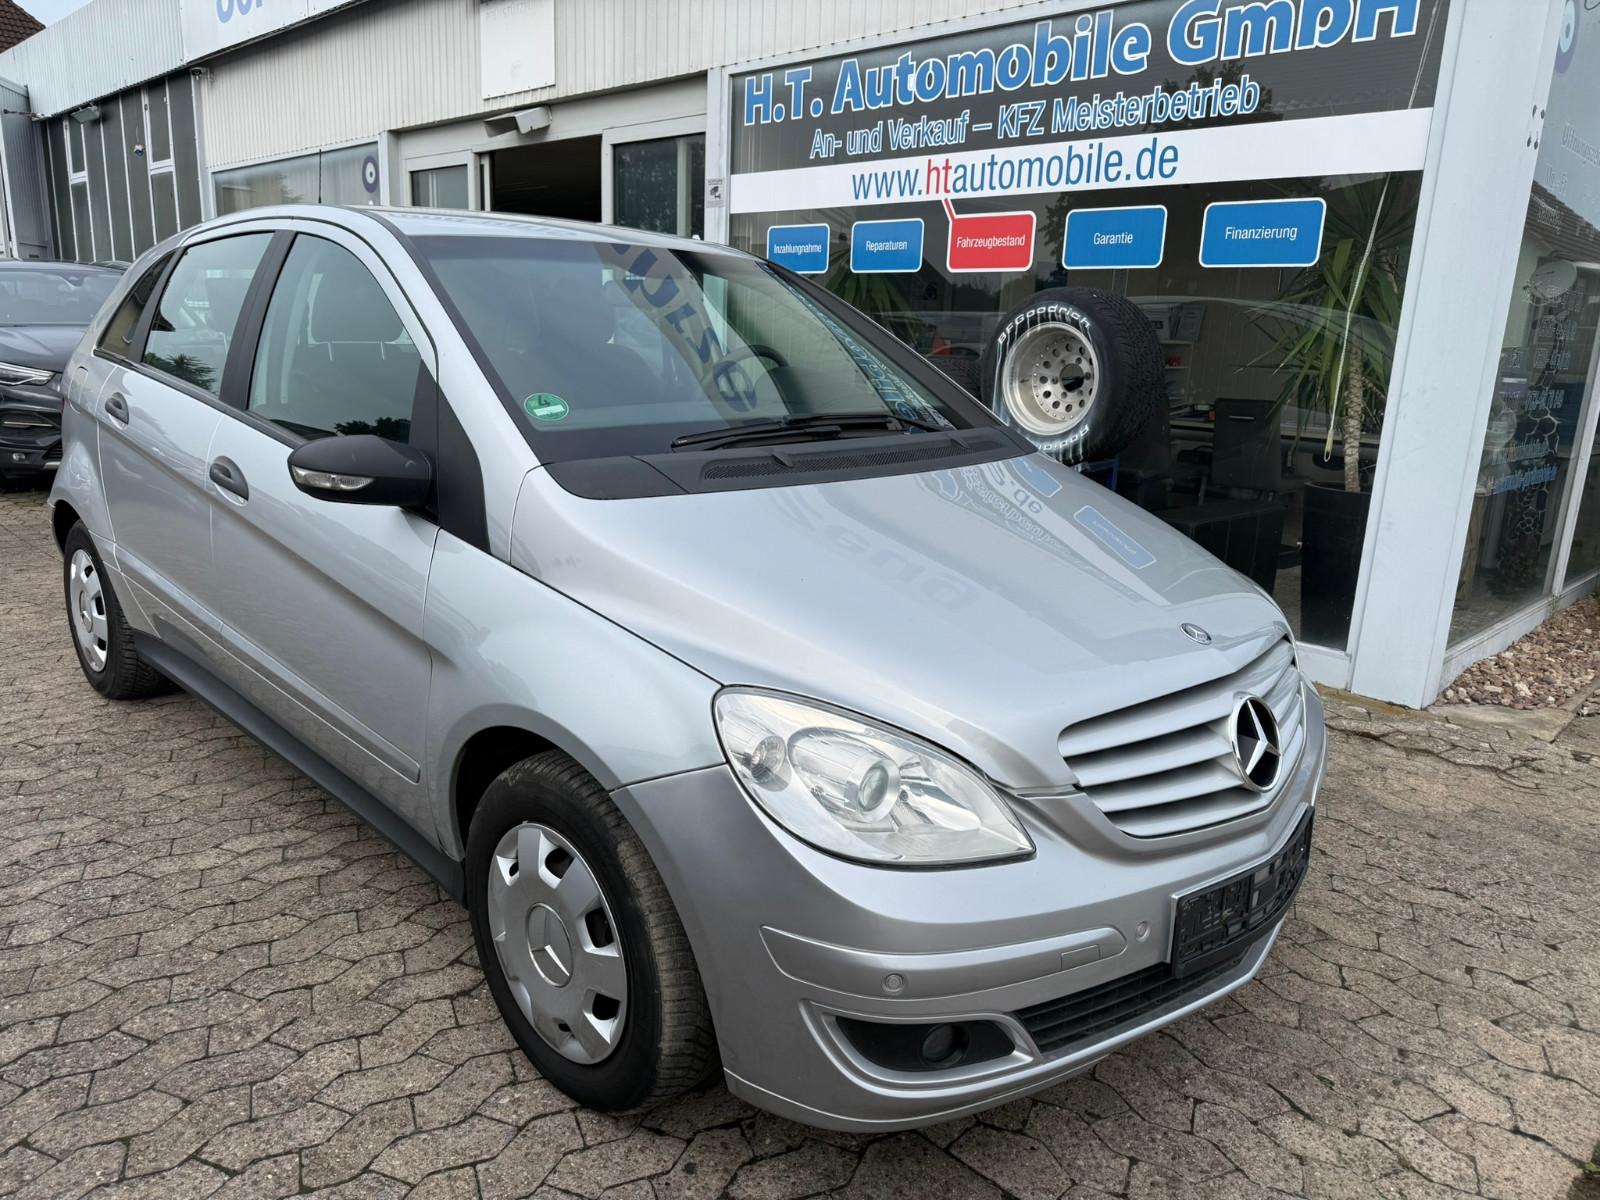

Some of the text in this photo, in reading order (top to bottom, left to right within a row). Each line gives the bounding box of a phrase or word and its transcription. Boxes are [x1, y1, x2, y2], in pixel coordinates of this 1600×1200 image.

[743, 0, 1421, 126] H.T. Automobile GmbH
[810, 129, 842, 159] An-
[847, 121, 883, 156] und
[888, 110, 969, 151] Verkauf
[997, 100, 1046, 139] KFZ
[1051, 75, 1260, 133] Meisterbetrieb
[852, 138, 1179, 200] www.htautomobile.de
[956, 234, 1026, 250] Fahrzeugbestand
[1093, 231, 1134, 245] Garantie
[1224, 226, 1298, 243] Finanzierung
[773, 242, 822, 256] Inzahlungnahme
[865, 239, 908, 253] Reparaturen
[997, 303, 1091, 345] BFGoodrich
